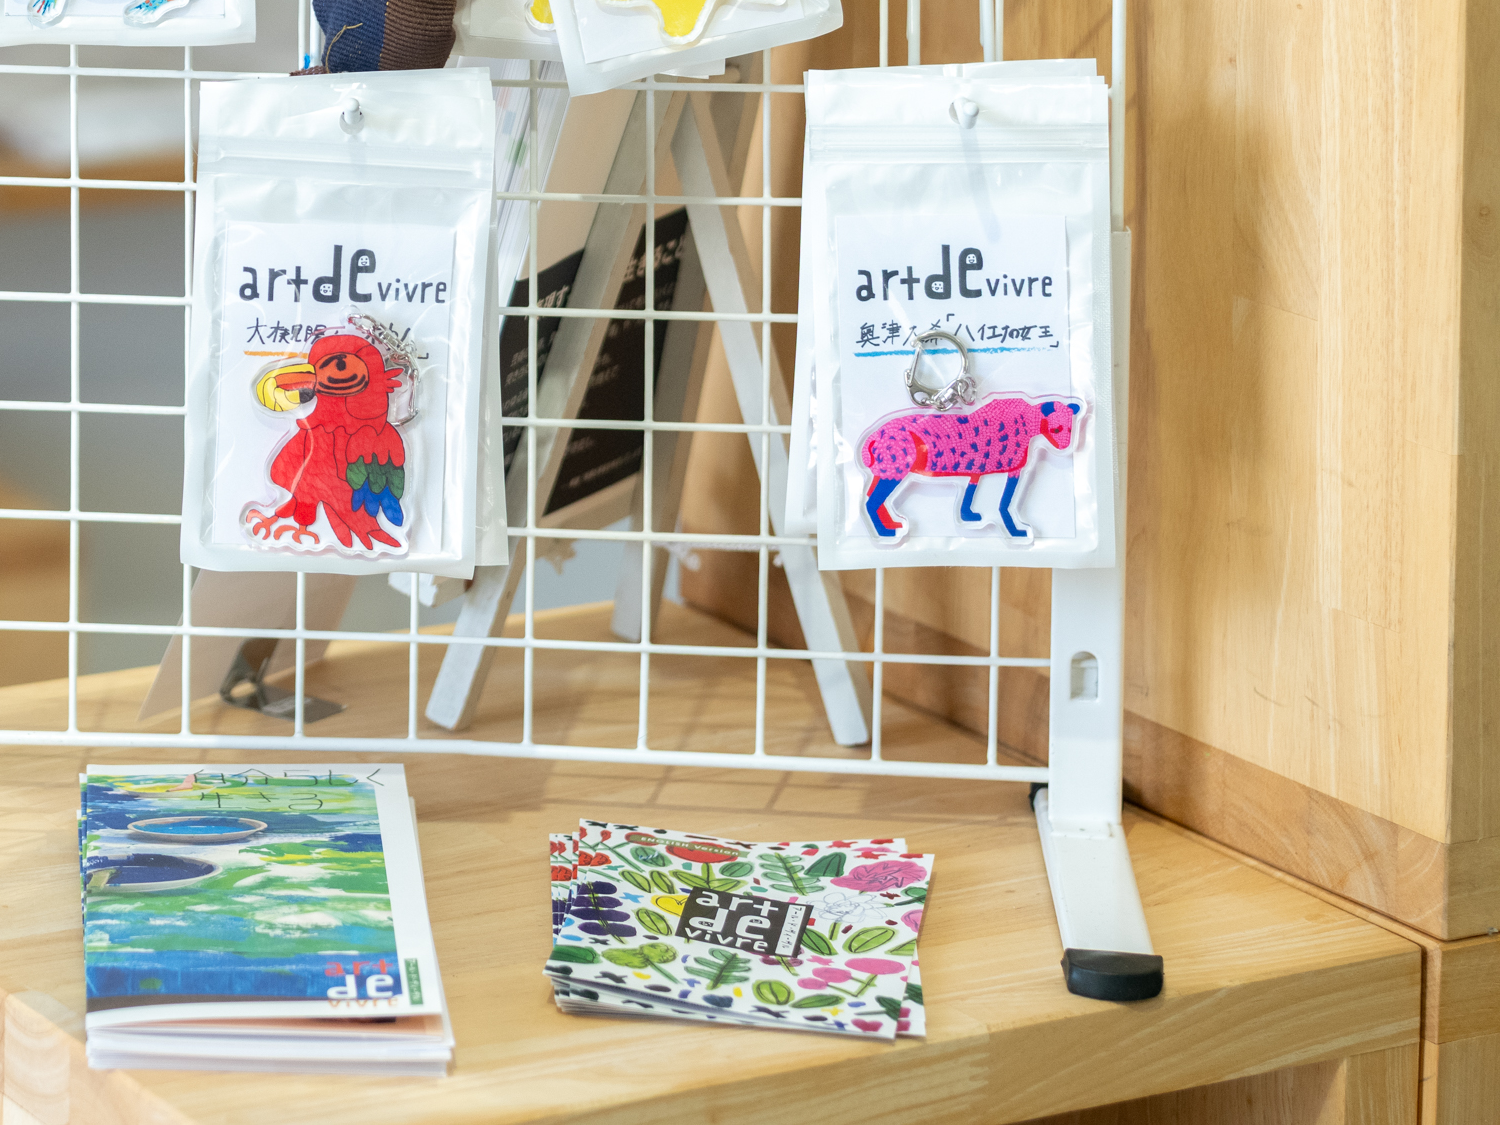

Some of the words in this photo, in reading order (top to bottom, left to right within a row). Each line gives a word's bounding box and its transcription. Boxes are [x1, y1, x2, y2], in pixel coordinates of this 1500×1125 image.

[694, 844, 739, 856] Version
[695, 890, 779, 916] art
[688, 908, 771, 939] de
[685, 927, 768, 952] vivre
[325, 959, 393, 977] art
[327, 974, 394, 1000] de
